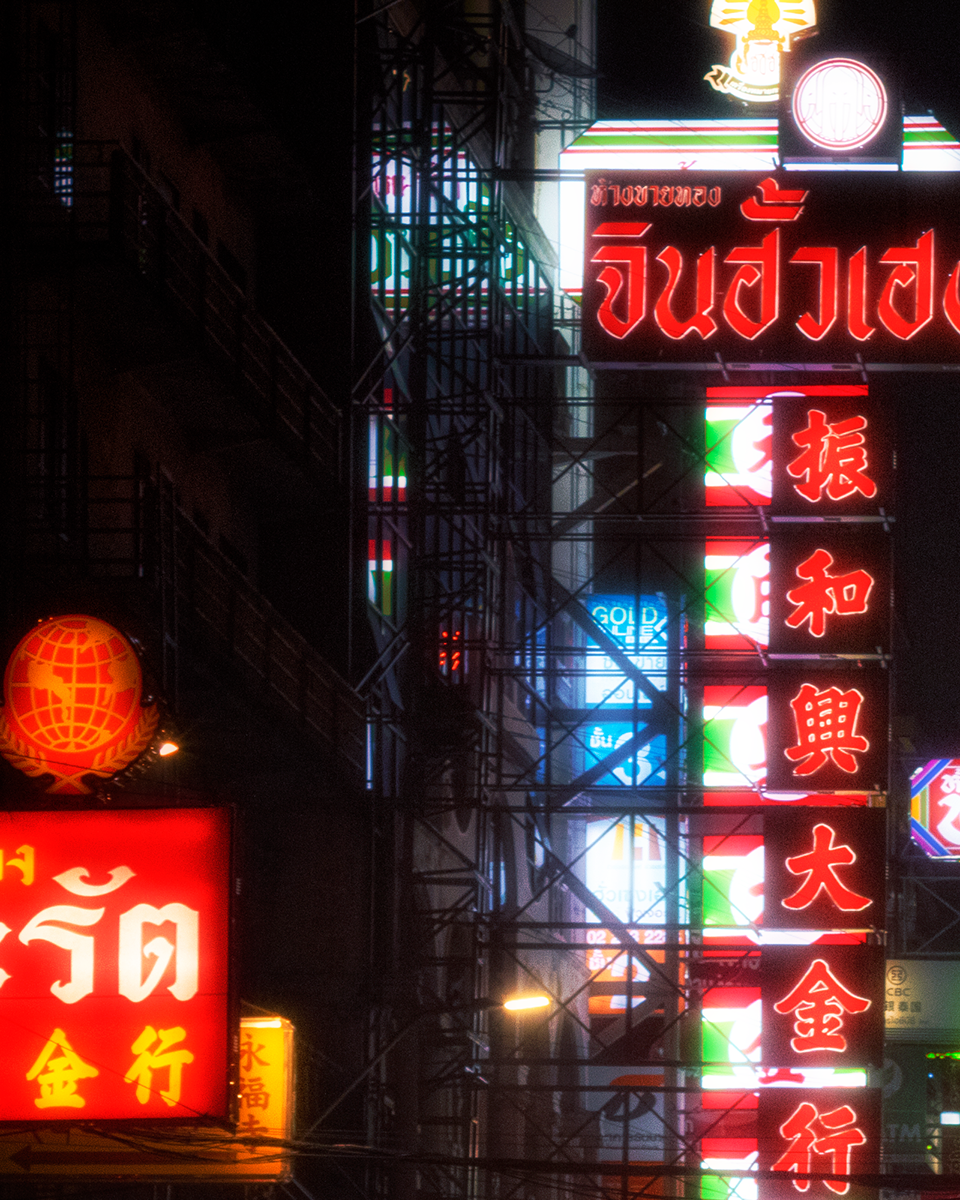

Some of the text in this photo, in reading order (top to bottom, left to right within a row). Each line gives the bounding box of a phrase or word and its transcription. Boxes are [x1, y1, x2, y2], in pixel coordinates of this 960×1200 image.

[592, 606, 658, 625] GOLD
[590, 727, 613, 748] ชั้น
[771, 409, 877, 1195] 振和興大金行
[886, 987, 912, 996] CBC
[26, 1026, 194, 1109] 金行
[886, 1123, 922, 1142] TM
